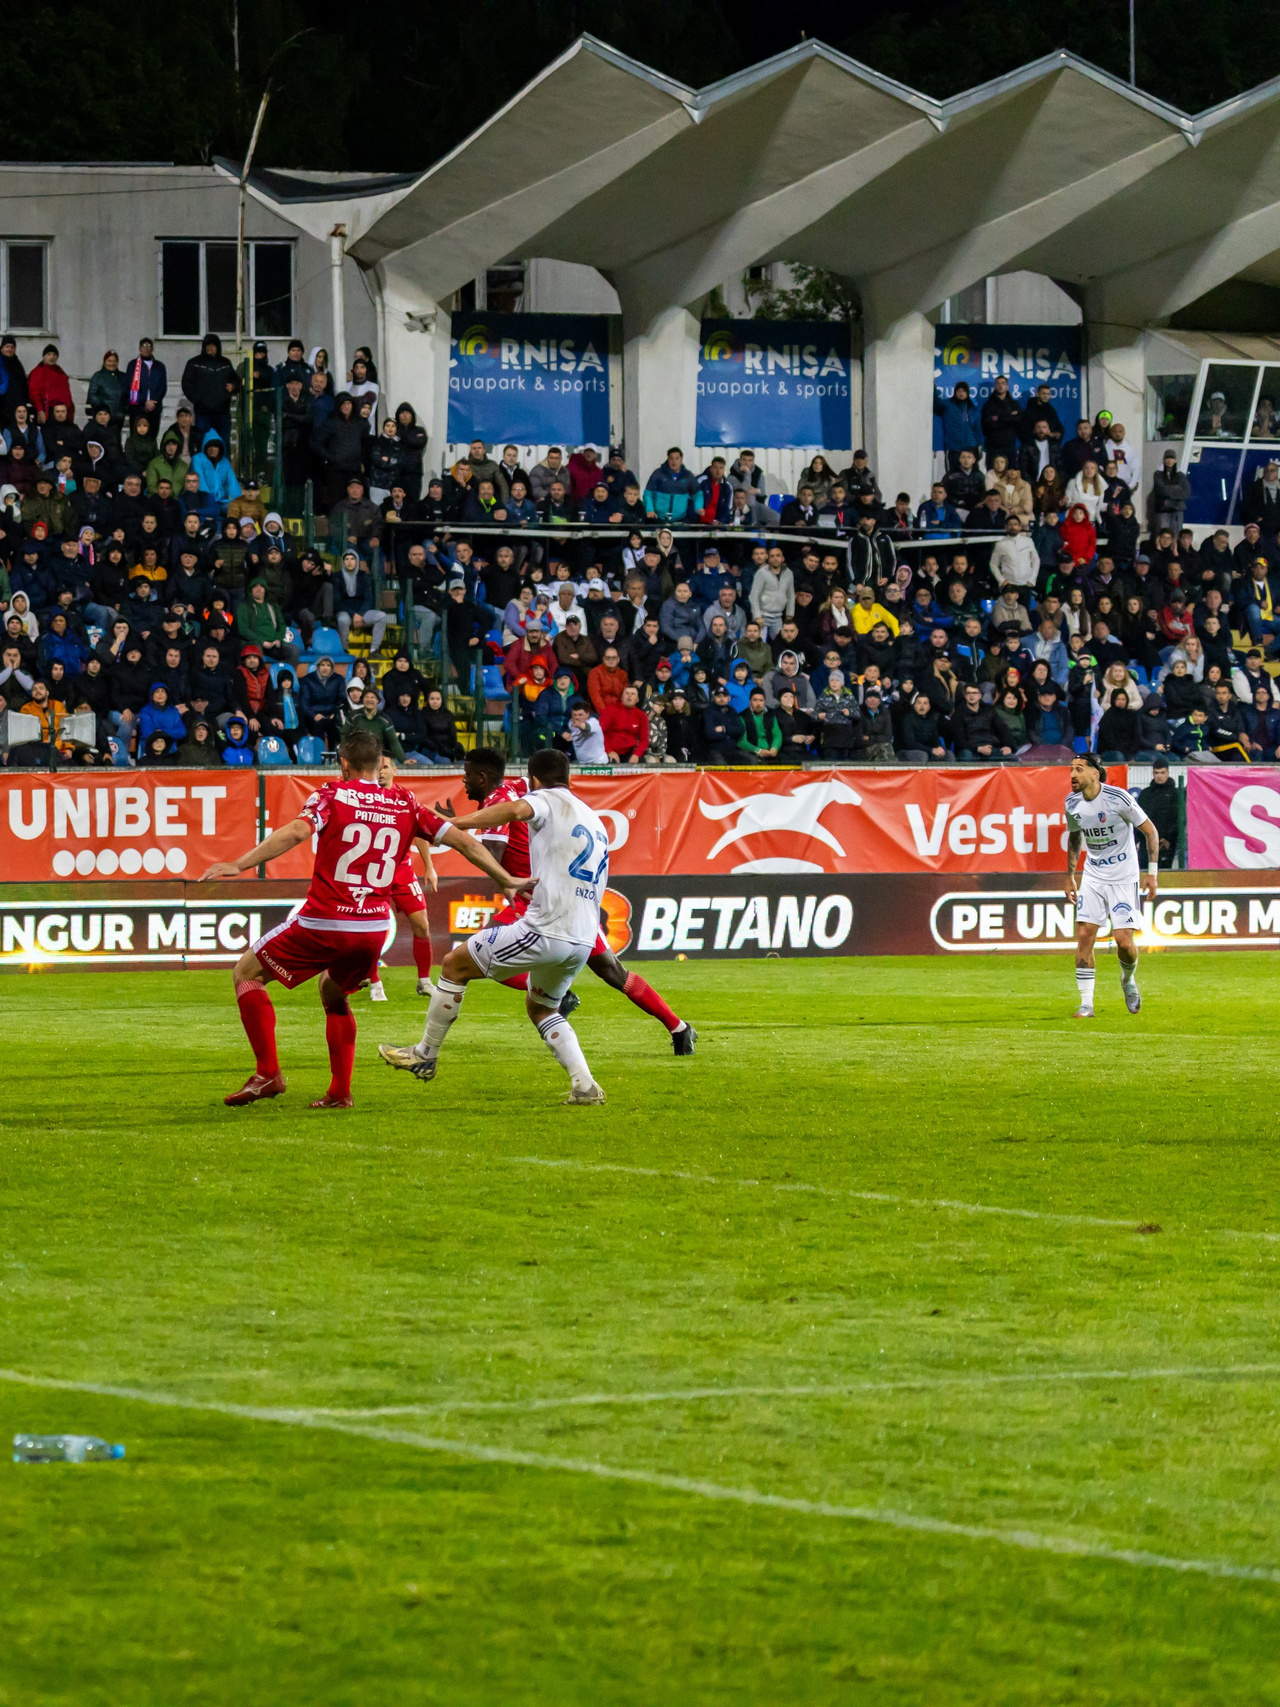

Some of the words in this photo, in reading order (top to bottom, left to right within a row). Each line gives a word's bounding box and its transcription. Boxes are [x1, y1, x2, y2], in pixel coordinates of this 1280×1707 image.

[450, 375, 525, 393] quapark
[553, 376, 606, 394] sports
[796, 382, 848, 399] sports
[1029, 385, 1078, 400] sorts
[8, 786, 226, 840] UNIBET
[333, 822, 401, 888] 23
[407, 880, 423, 897] 18
[356, 905, 386, 914] GAMING
[455, 907, 496, 928] BET
[148, 912, 262, 951] MECI
[637, 895, 854, 951] BETANO
[952, 905, 1005, 939] PE
[1017, 903, 1074, 938] UN
